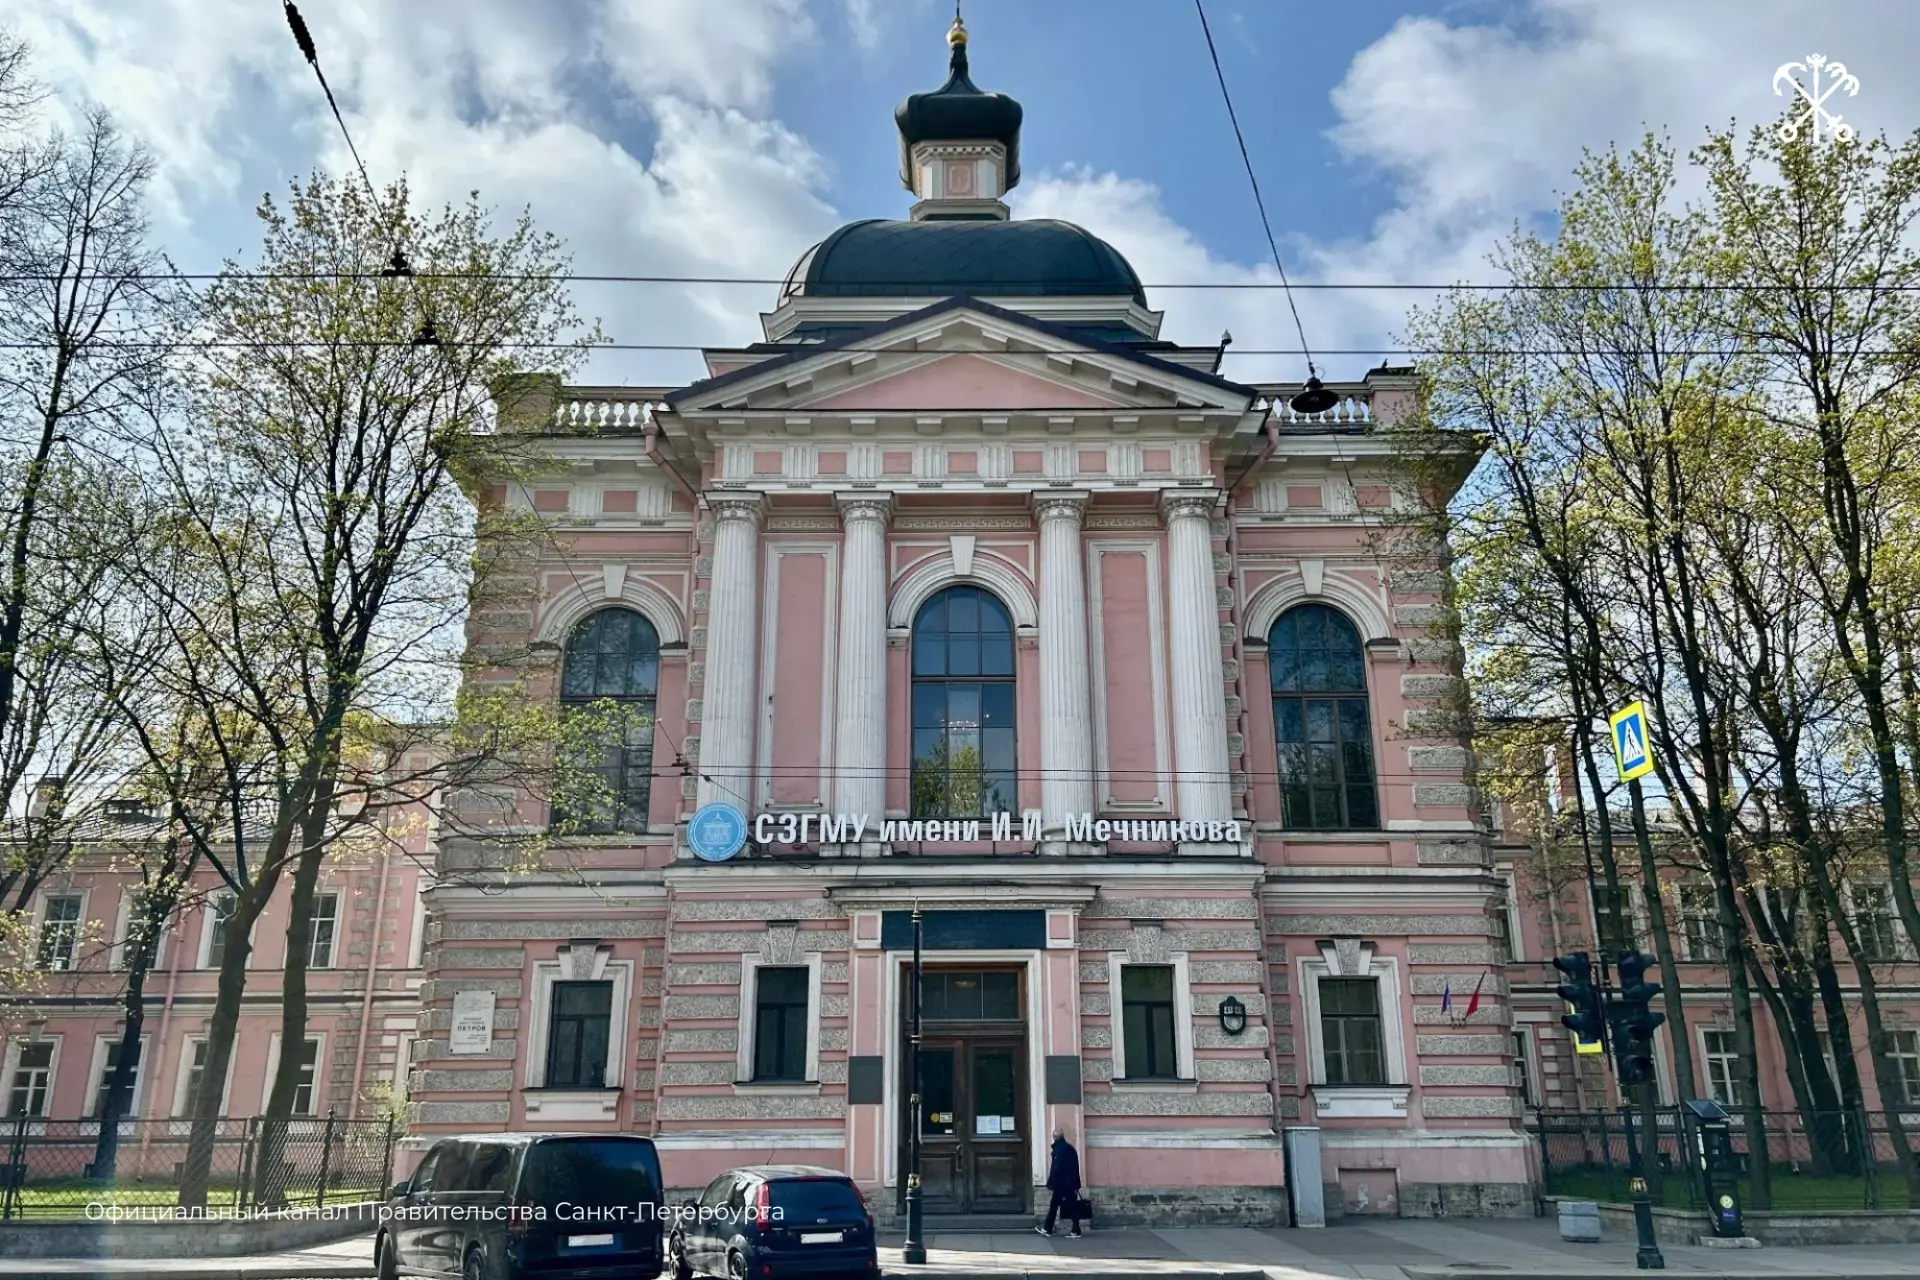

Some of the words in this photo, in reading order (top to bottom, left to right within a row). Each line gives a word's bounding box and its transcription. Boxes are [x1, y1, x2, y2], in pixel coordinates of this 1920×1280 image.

[756, 813, 870, 844] СЗГМУ
[879, 818, 980, 842] имени
[991, 809, 1051, 842] И.И.
[1065, 812, 1243, 842] Мечникова
